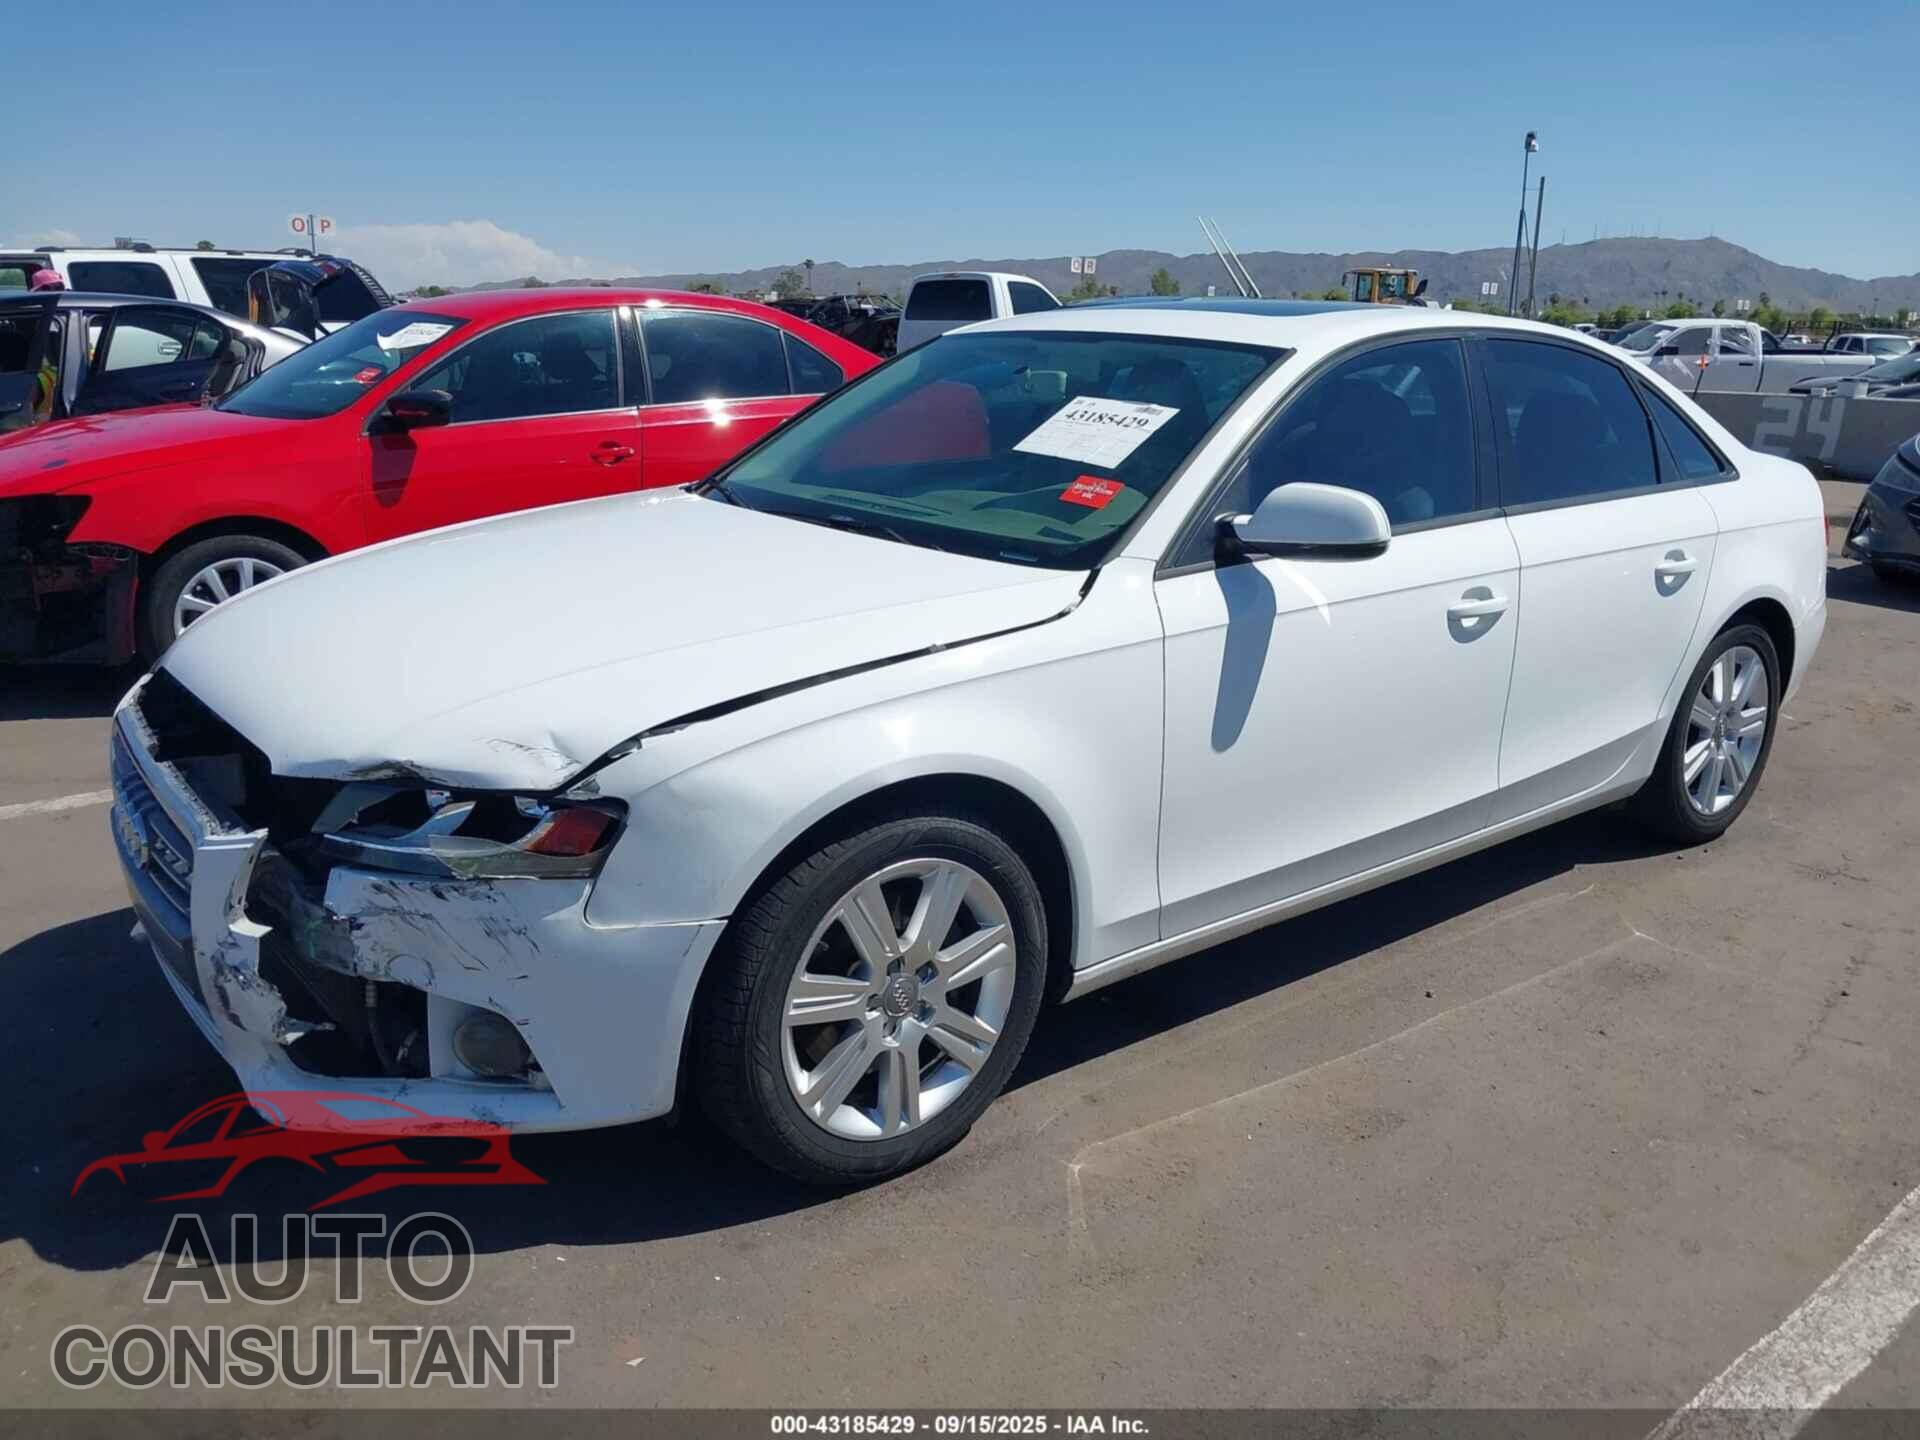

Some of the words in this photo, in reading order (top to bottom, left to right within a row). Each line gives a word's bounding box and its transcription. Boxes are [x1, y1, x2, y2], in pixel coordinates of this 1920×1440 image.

[291, 217, 305, 233] O
[320, 219, 331, 233] P
[1065, 409, 1150, 429] 43185429
[1752, 397, 1846, 460] 24
